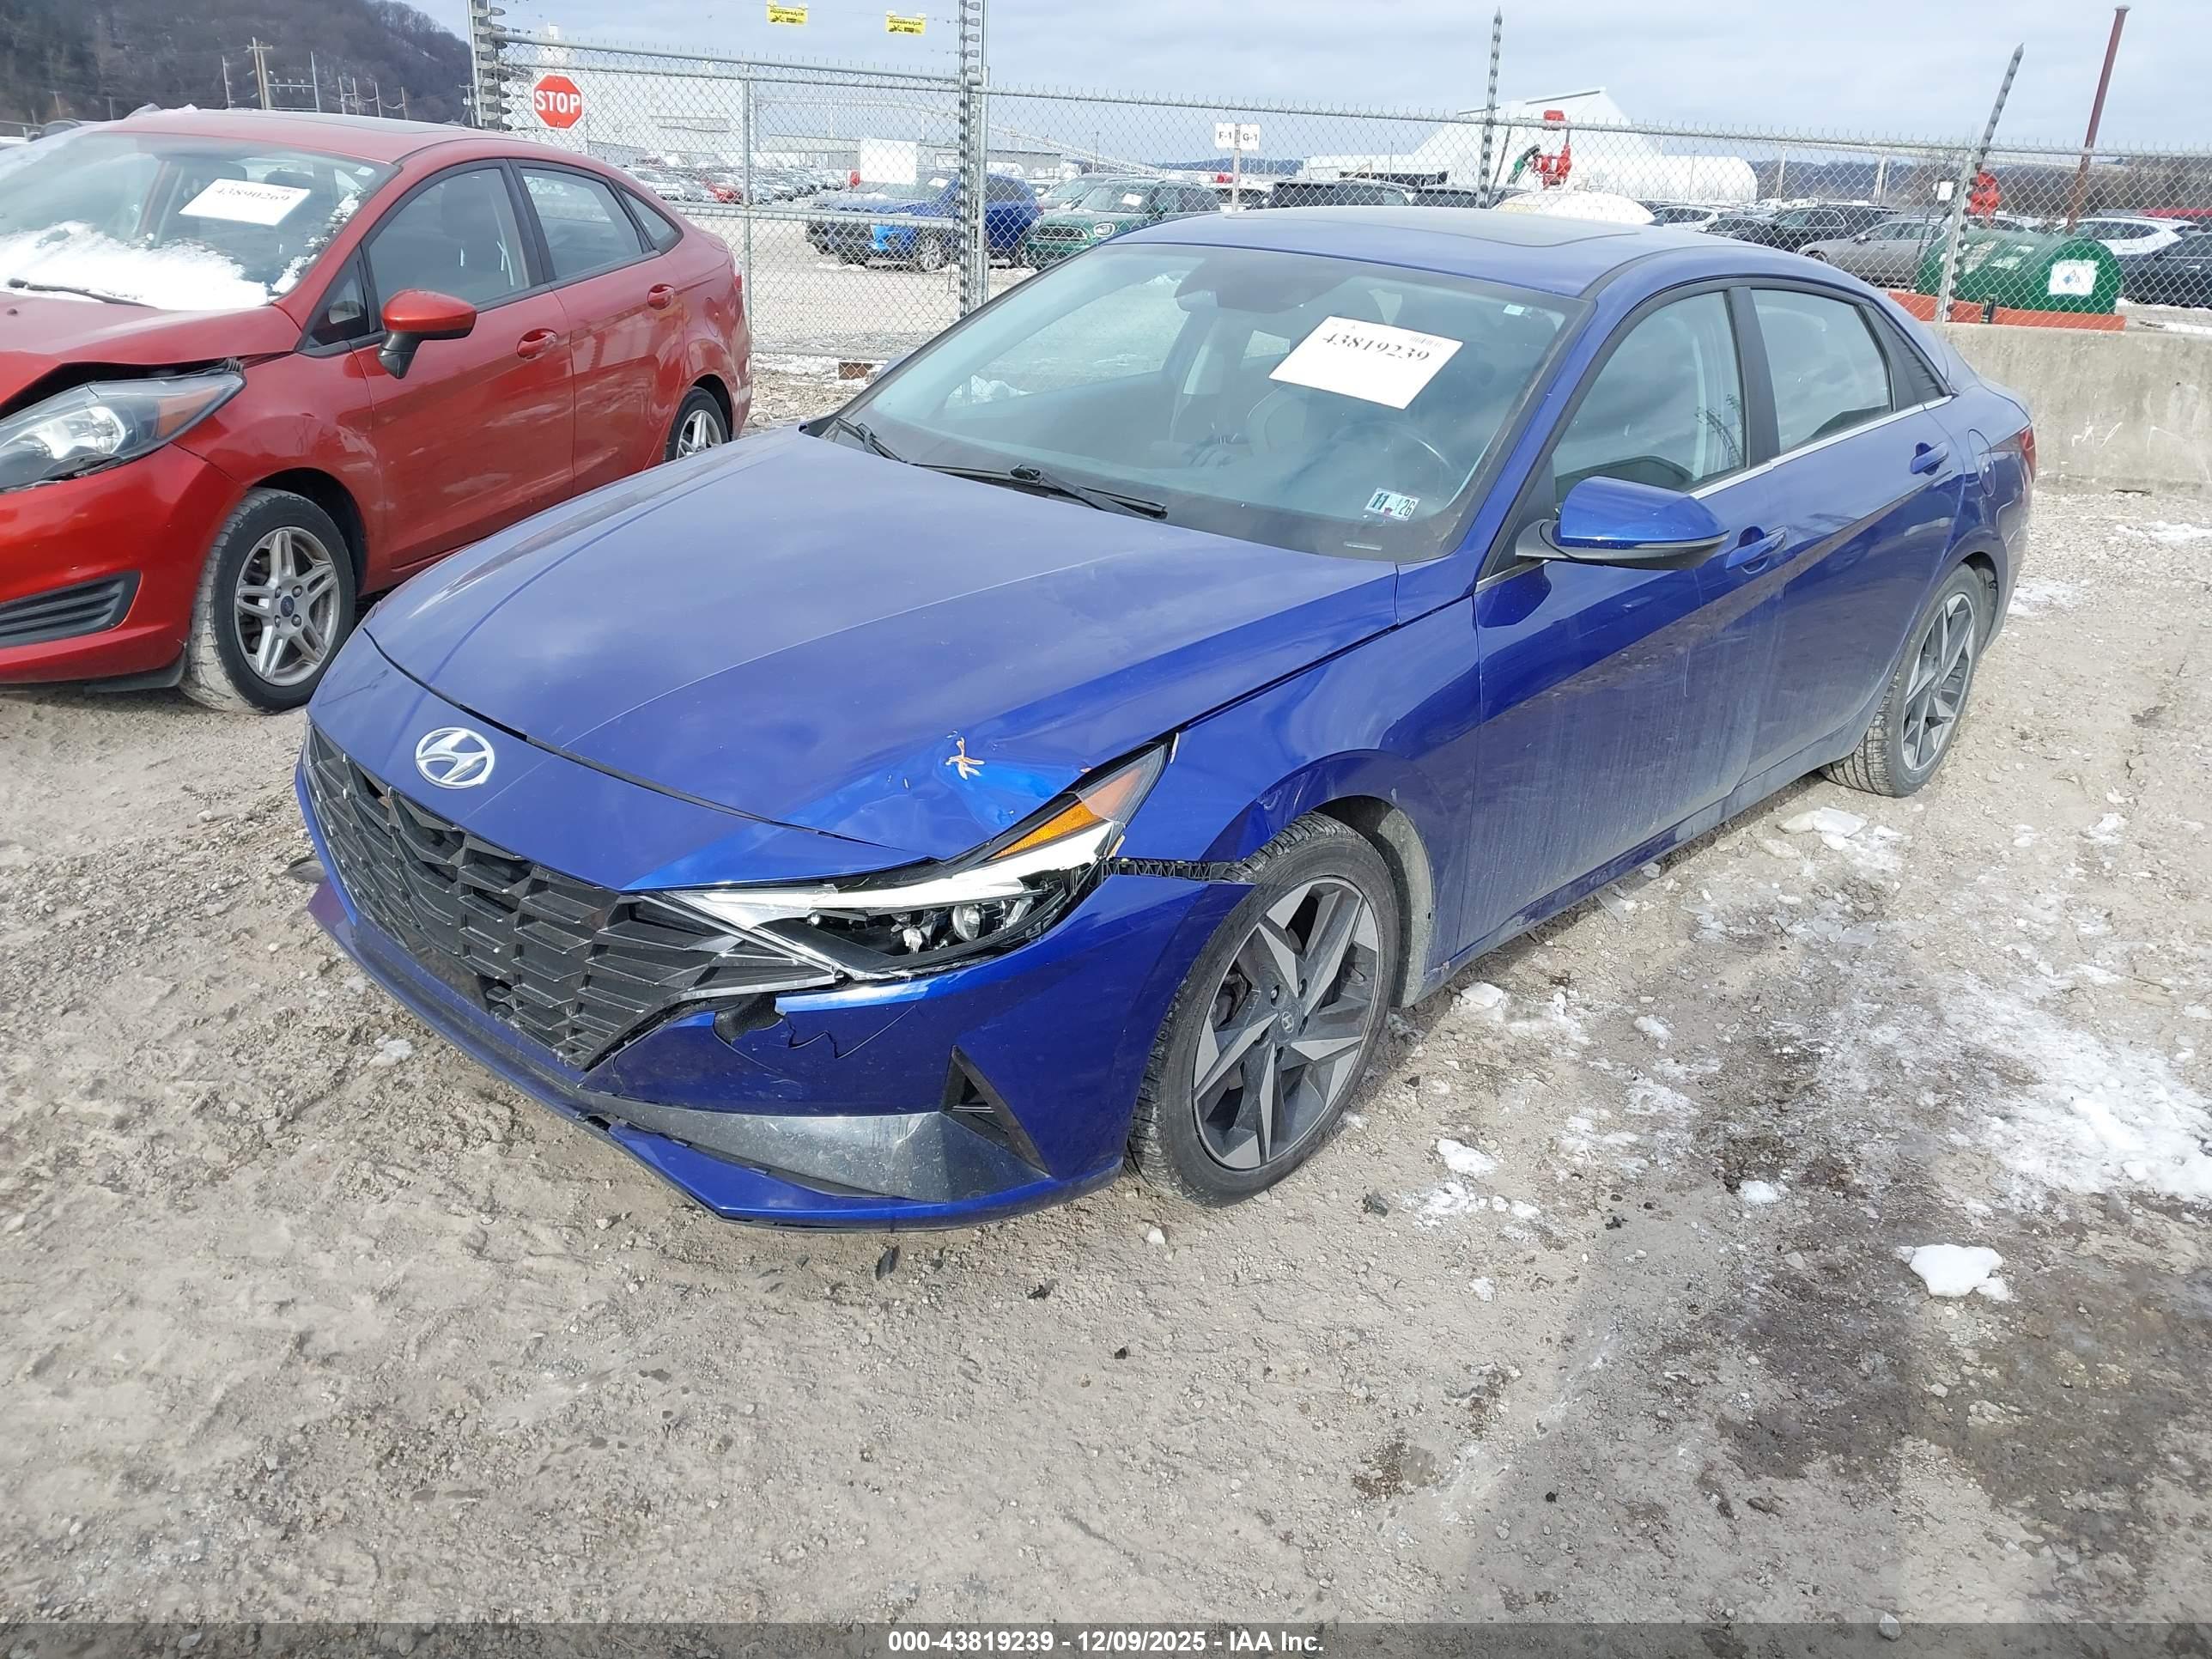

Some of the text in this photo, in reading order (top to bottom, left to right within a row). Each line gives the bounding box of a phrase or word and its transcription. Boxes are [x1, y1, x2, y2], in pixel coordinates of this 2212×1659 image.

[535, 89, 580, 114] STOP
[1218, 131, 1231, 139] F-1
[1243, 132, 1257, 142] G-1
[1322, 332, 1430, 362] 43819239
[1371, 493, 1391, 510] 11
[1398, 499, 1416, 517] 26
